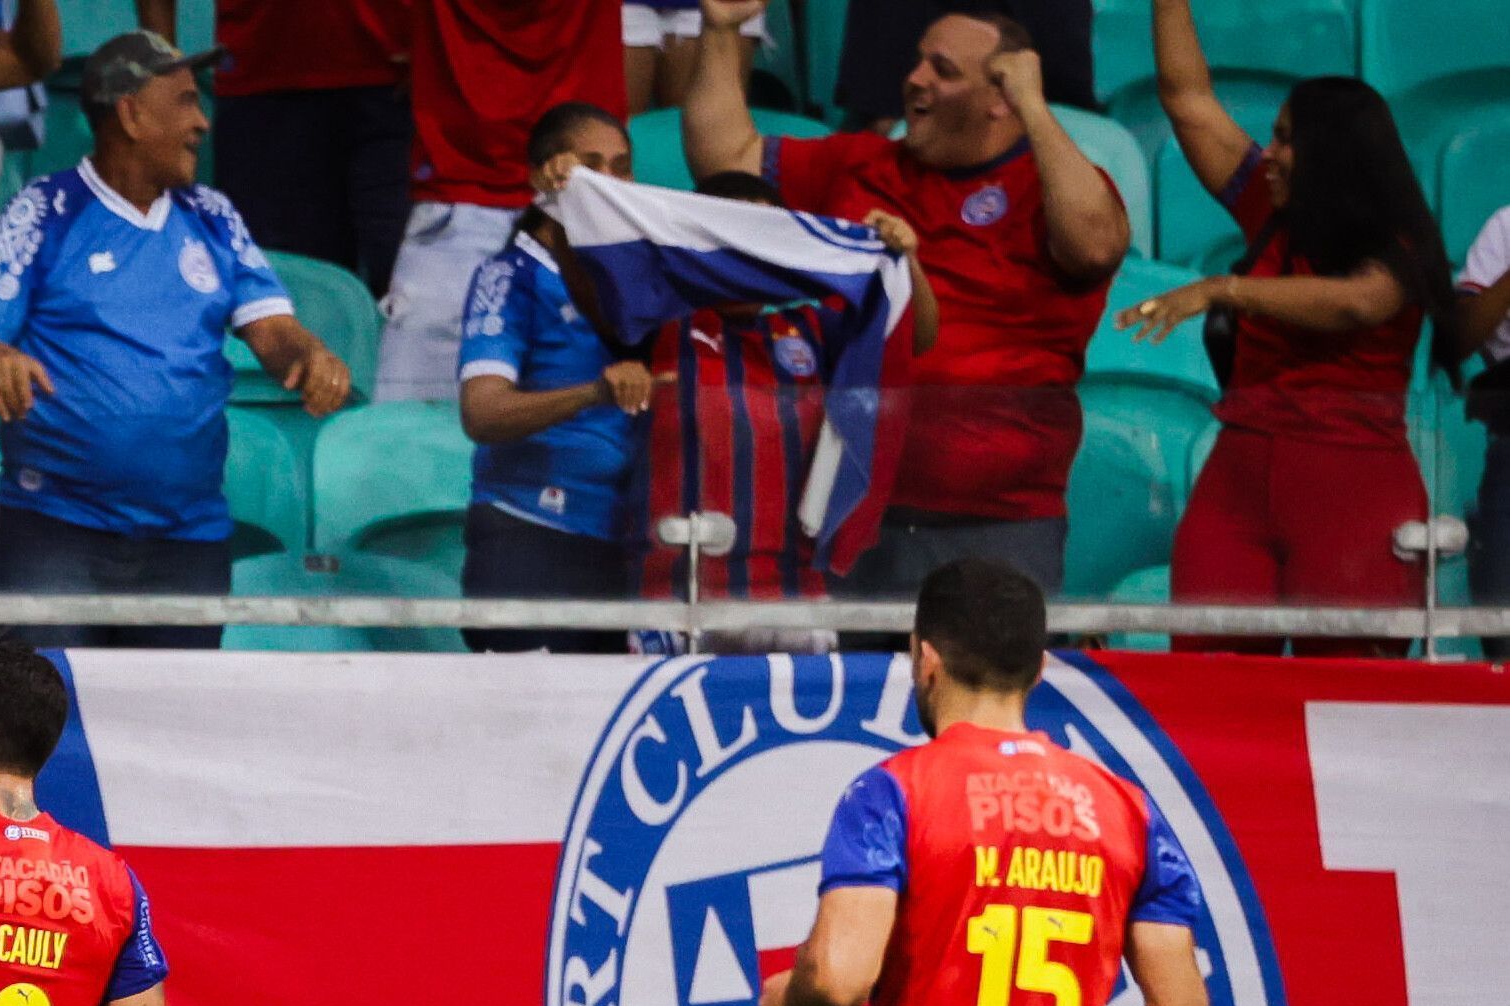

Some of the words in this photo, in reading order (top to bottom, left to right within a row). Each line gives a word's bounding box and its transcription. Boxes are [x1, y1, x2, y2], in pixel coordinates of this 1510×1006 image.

[969, 793, 1102, 843] PISOS
[974, 845, 1001, 888] M.
[1005, 845, 1105, 898] ARAUJO
